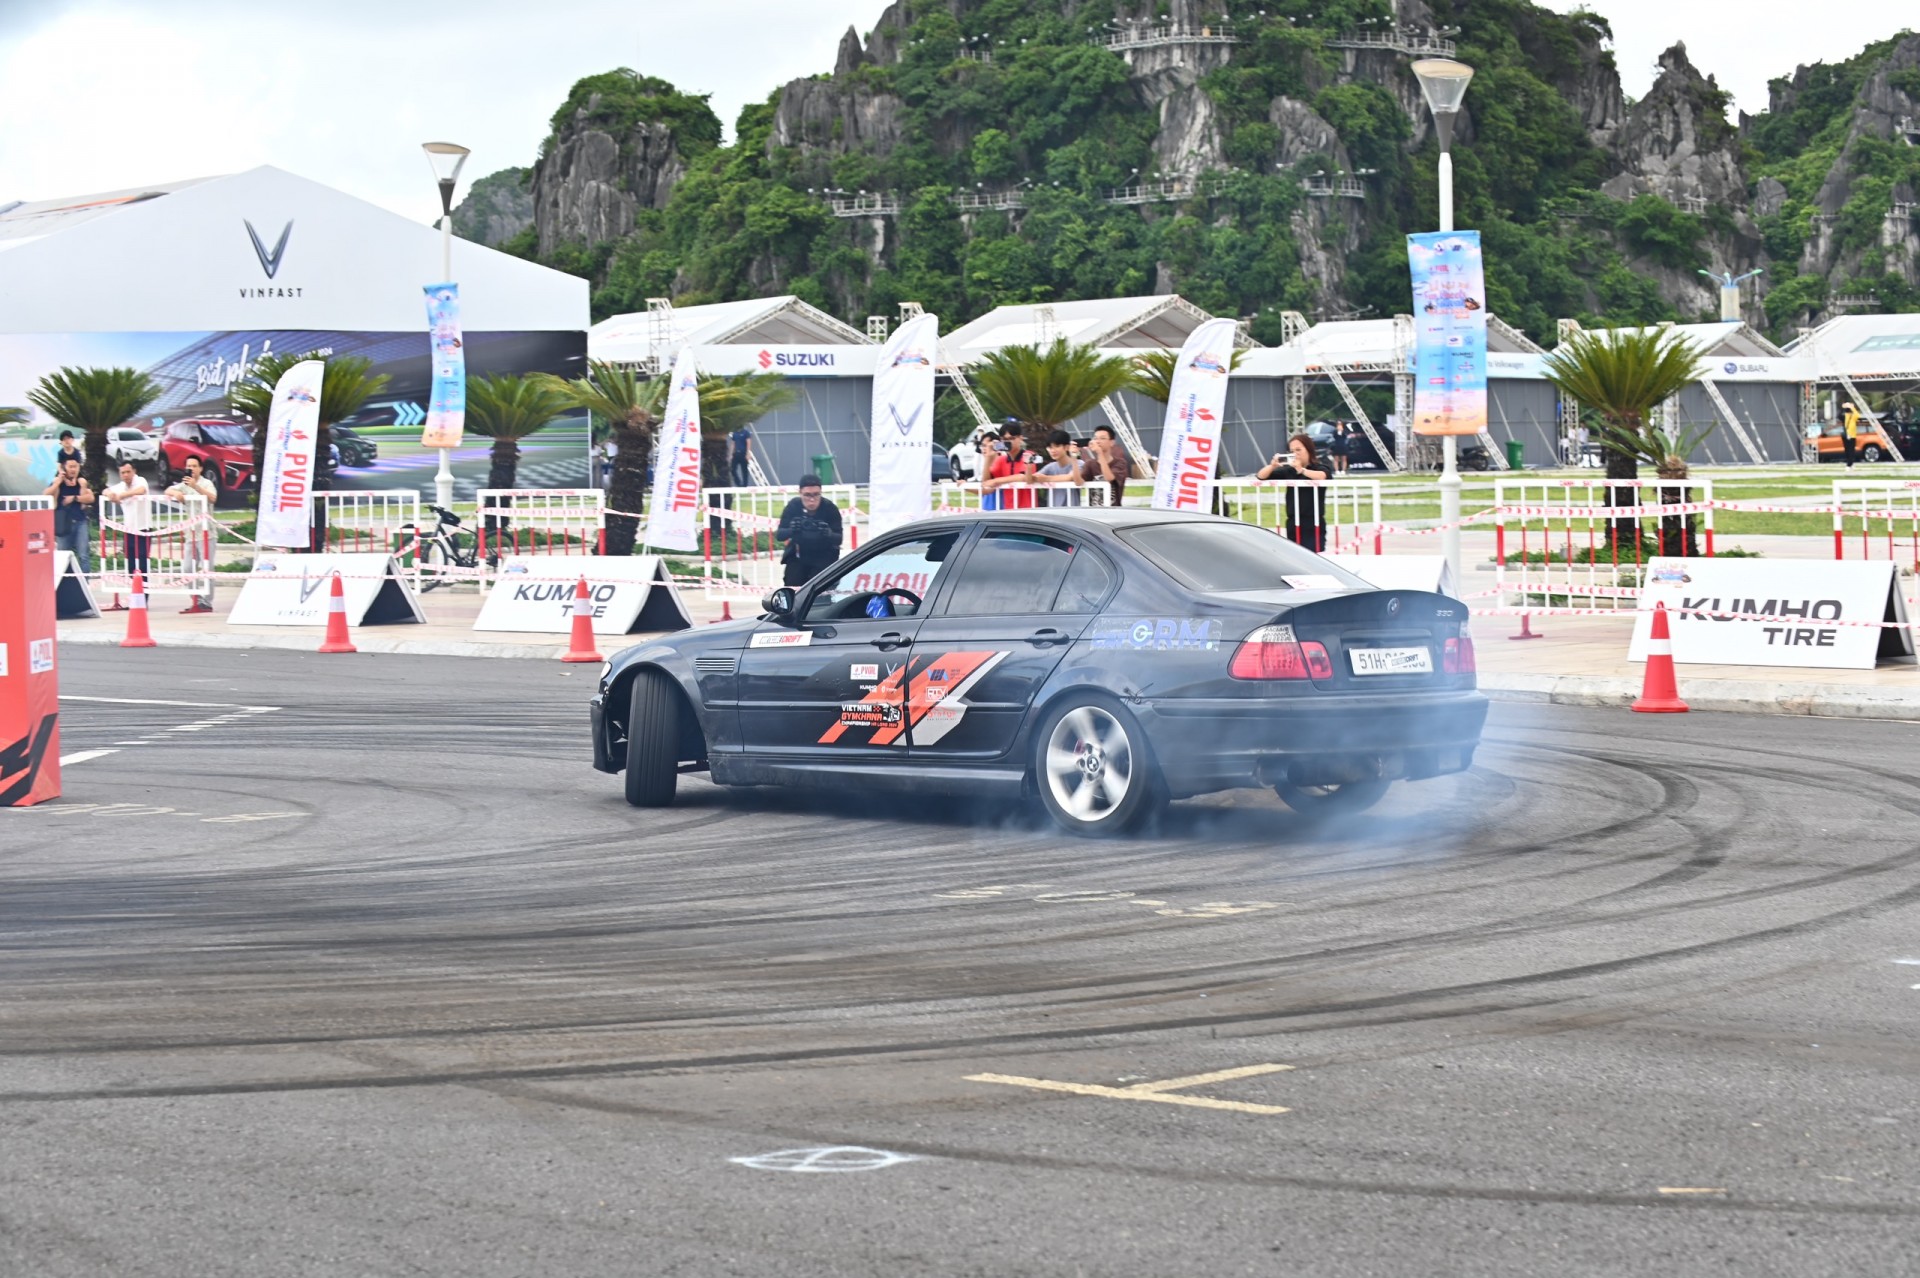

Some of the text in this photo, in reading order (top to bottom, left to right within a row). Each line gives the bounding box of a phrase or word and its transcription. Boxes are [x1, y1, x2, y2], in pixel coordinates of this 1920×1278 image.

[239, 287, 302, 298] VINFAST
[775, 352, 835, 367] SUZUKI
[1740, 364, 1769, 373] SUBARU
[673, 446, 699, 513] PVOIL
[1175, 435, 1213, 509] PVOIL
[279, 452, 308, 513] PVOIL
[1679, 597, 1842, 622] KUMHO
[1762, 627, 1837, 647] TIRE
[841, 704, 873, 712] VIETNAM
[841, 712, 882, 721] GYMKHANA
